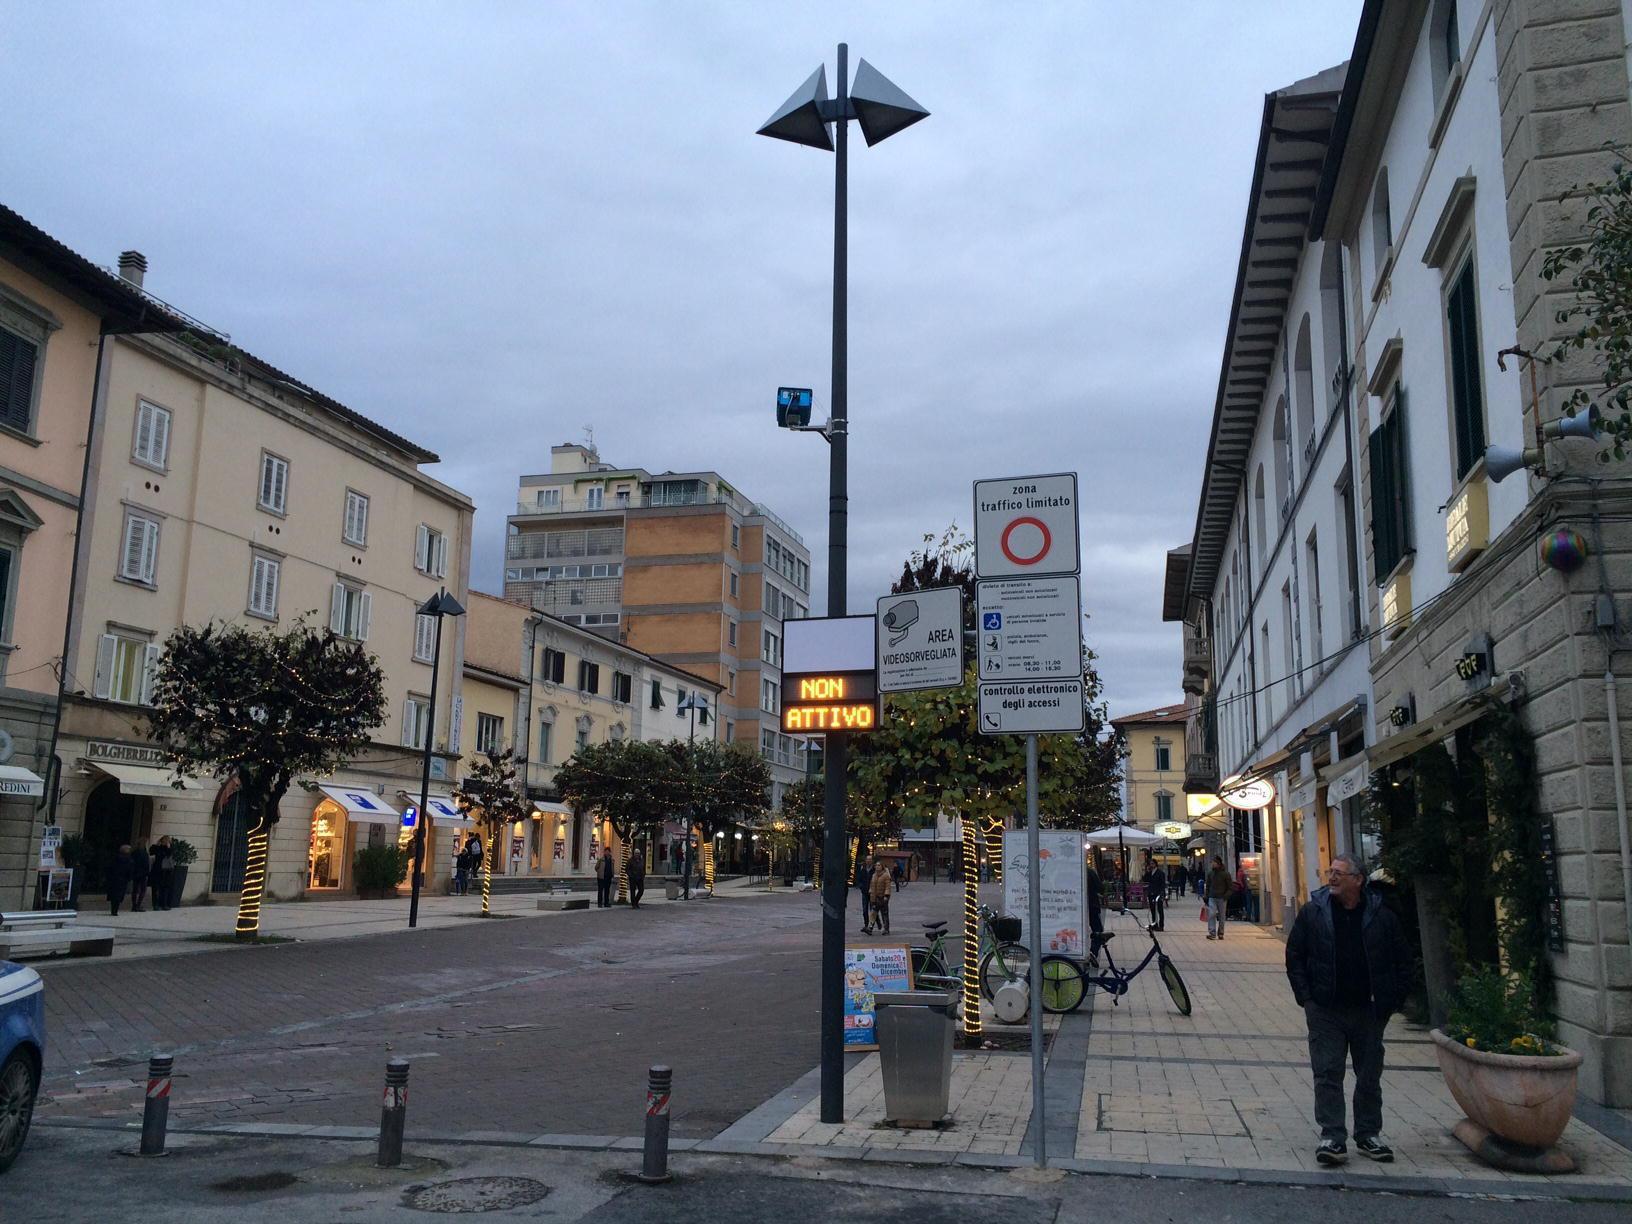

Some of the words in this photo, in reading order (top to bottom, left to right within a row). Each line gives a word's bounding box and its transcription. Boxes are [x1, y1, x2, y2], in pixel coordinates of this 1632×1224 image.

[1012, 484, 1037, 495] zona
[981, 500, 1023, 512] traffico
[1026, 496, 1070, 509] limitato
[927, 628, 954, 644] AREA
[883, 647, 957, 665] VIDEOSORVEGLIATA
[800, 678, 843, 699] NON
[983, 684, 1025, 696] controllo
[1028, 683, 1078, 695] elettronico
[1002, 697, 1025, 710] degli
[1028, 697, 1060, 709] accessi
[787, 706, 871, 728] ATTIVO
